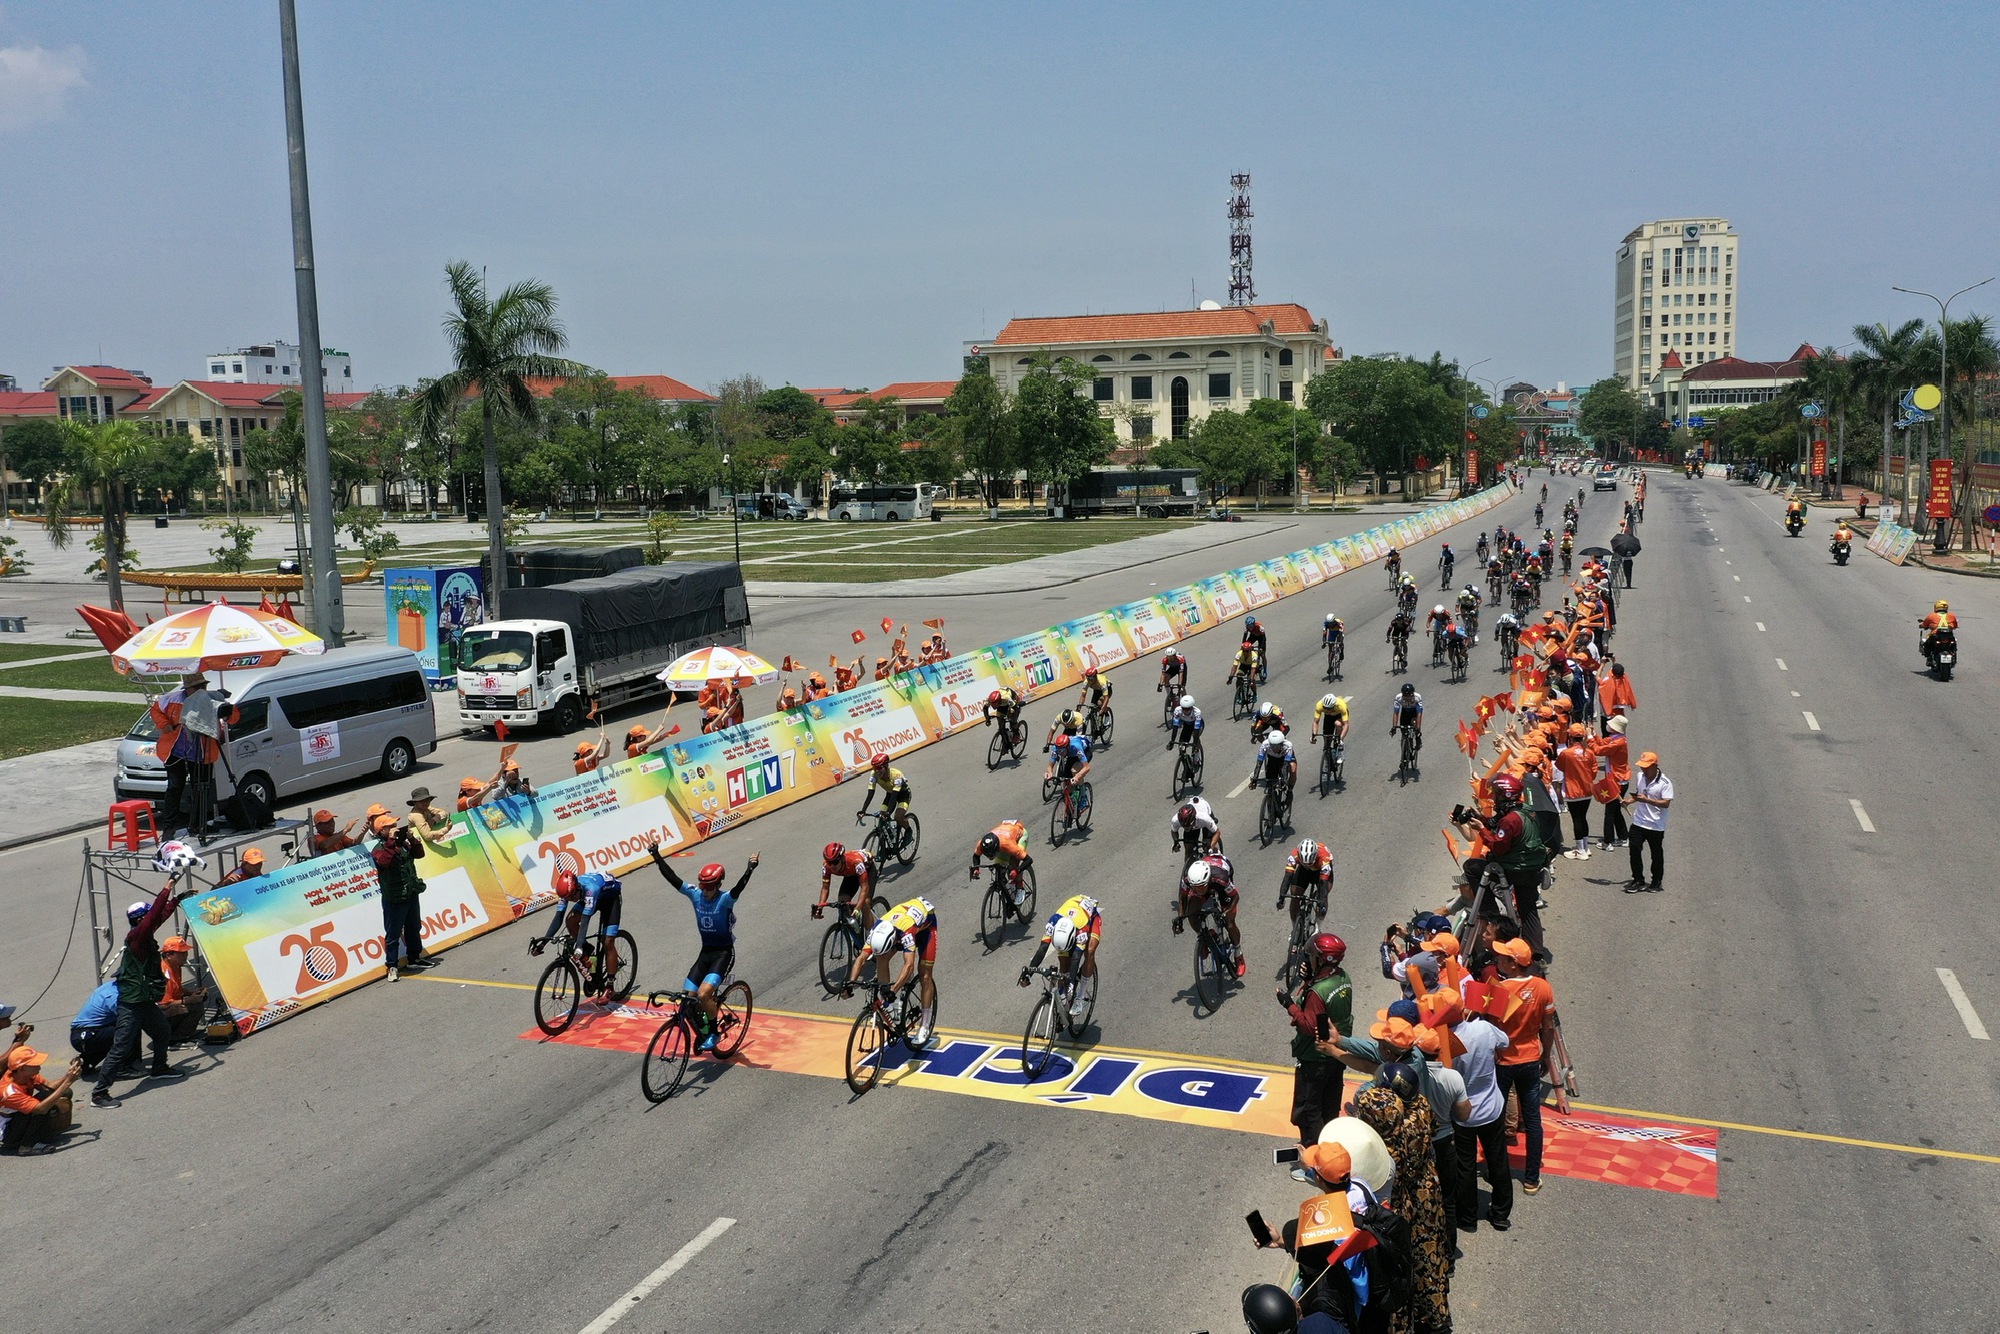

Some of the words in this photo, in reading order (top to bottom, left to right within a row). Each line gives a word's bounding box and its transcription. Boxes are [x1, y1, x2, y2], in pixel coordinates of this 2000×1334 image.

[166, 631, 191, 643] 25
[145, 662, 160, 673] 25
[229, 655, 261, 667] HTV
[941, 693, 965, 726] 25
[843, 728, 872, 765] 25
[871, 741, 891, 755] TON
[890, 729, 913, 749] DONG
[912, 726, 921, 738] A
[538, 833, 586, 891] 25
[585, 846, 618, 870] TON
[619, 828, 663, 858] DONG
[661, 824, 675, 841] A
[254, 885, 270, 895] CUỘC
[269, 881, 281, 890] ĐUA
[279, 879, 287, 887] XE
[286, 875, 297, 886] ĐẠP
[296, 871, 310, 881] TOÀN
[309, 867, 323, 878] QUỐC
[321, 863, 338, 873] TRANH
[336, 859, 347, 868] CÚP
[304, 888, 323, 900] NON
[324, 880, 348, 893] SÔNG
[348, 874, 364, 885] LIỀN
[365, 868, 379, 878] MỘ
[310, 894, 331, 908] NIỀM
[332, 890, 347, 900] TIN
[348, 881, 371, 894] CHIẾN
[419, 907, 458, 940] ONG
[458, 902, 477, 924] A
[280, 921, 349, 995] 25
[1304, 1199, 1333, 1230] 25
[1301, 1232, 1317, 1240] TON
[1316, 1228, 1338, 1237] DONG
